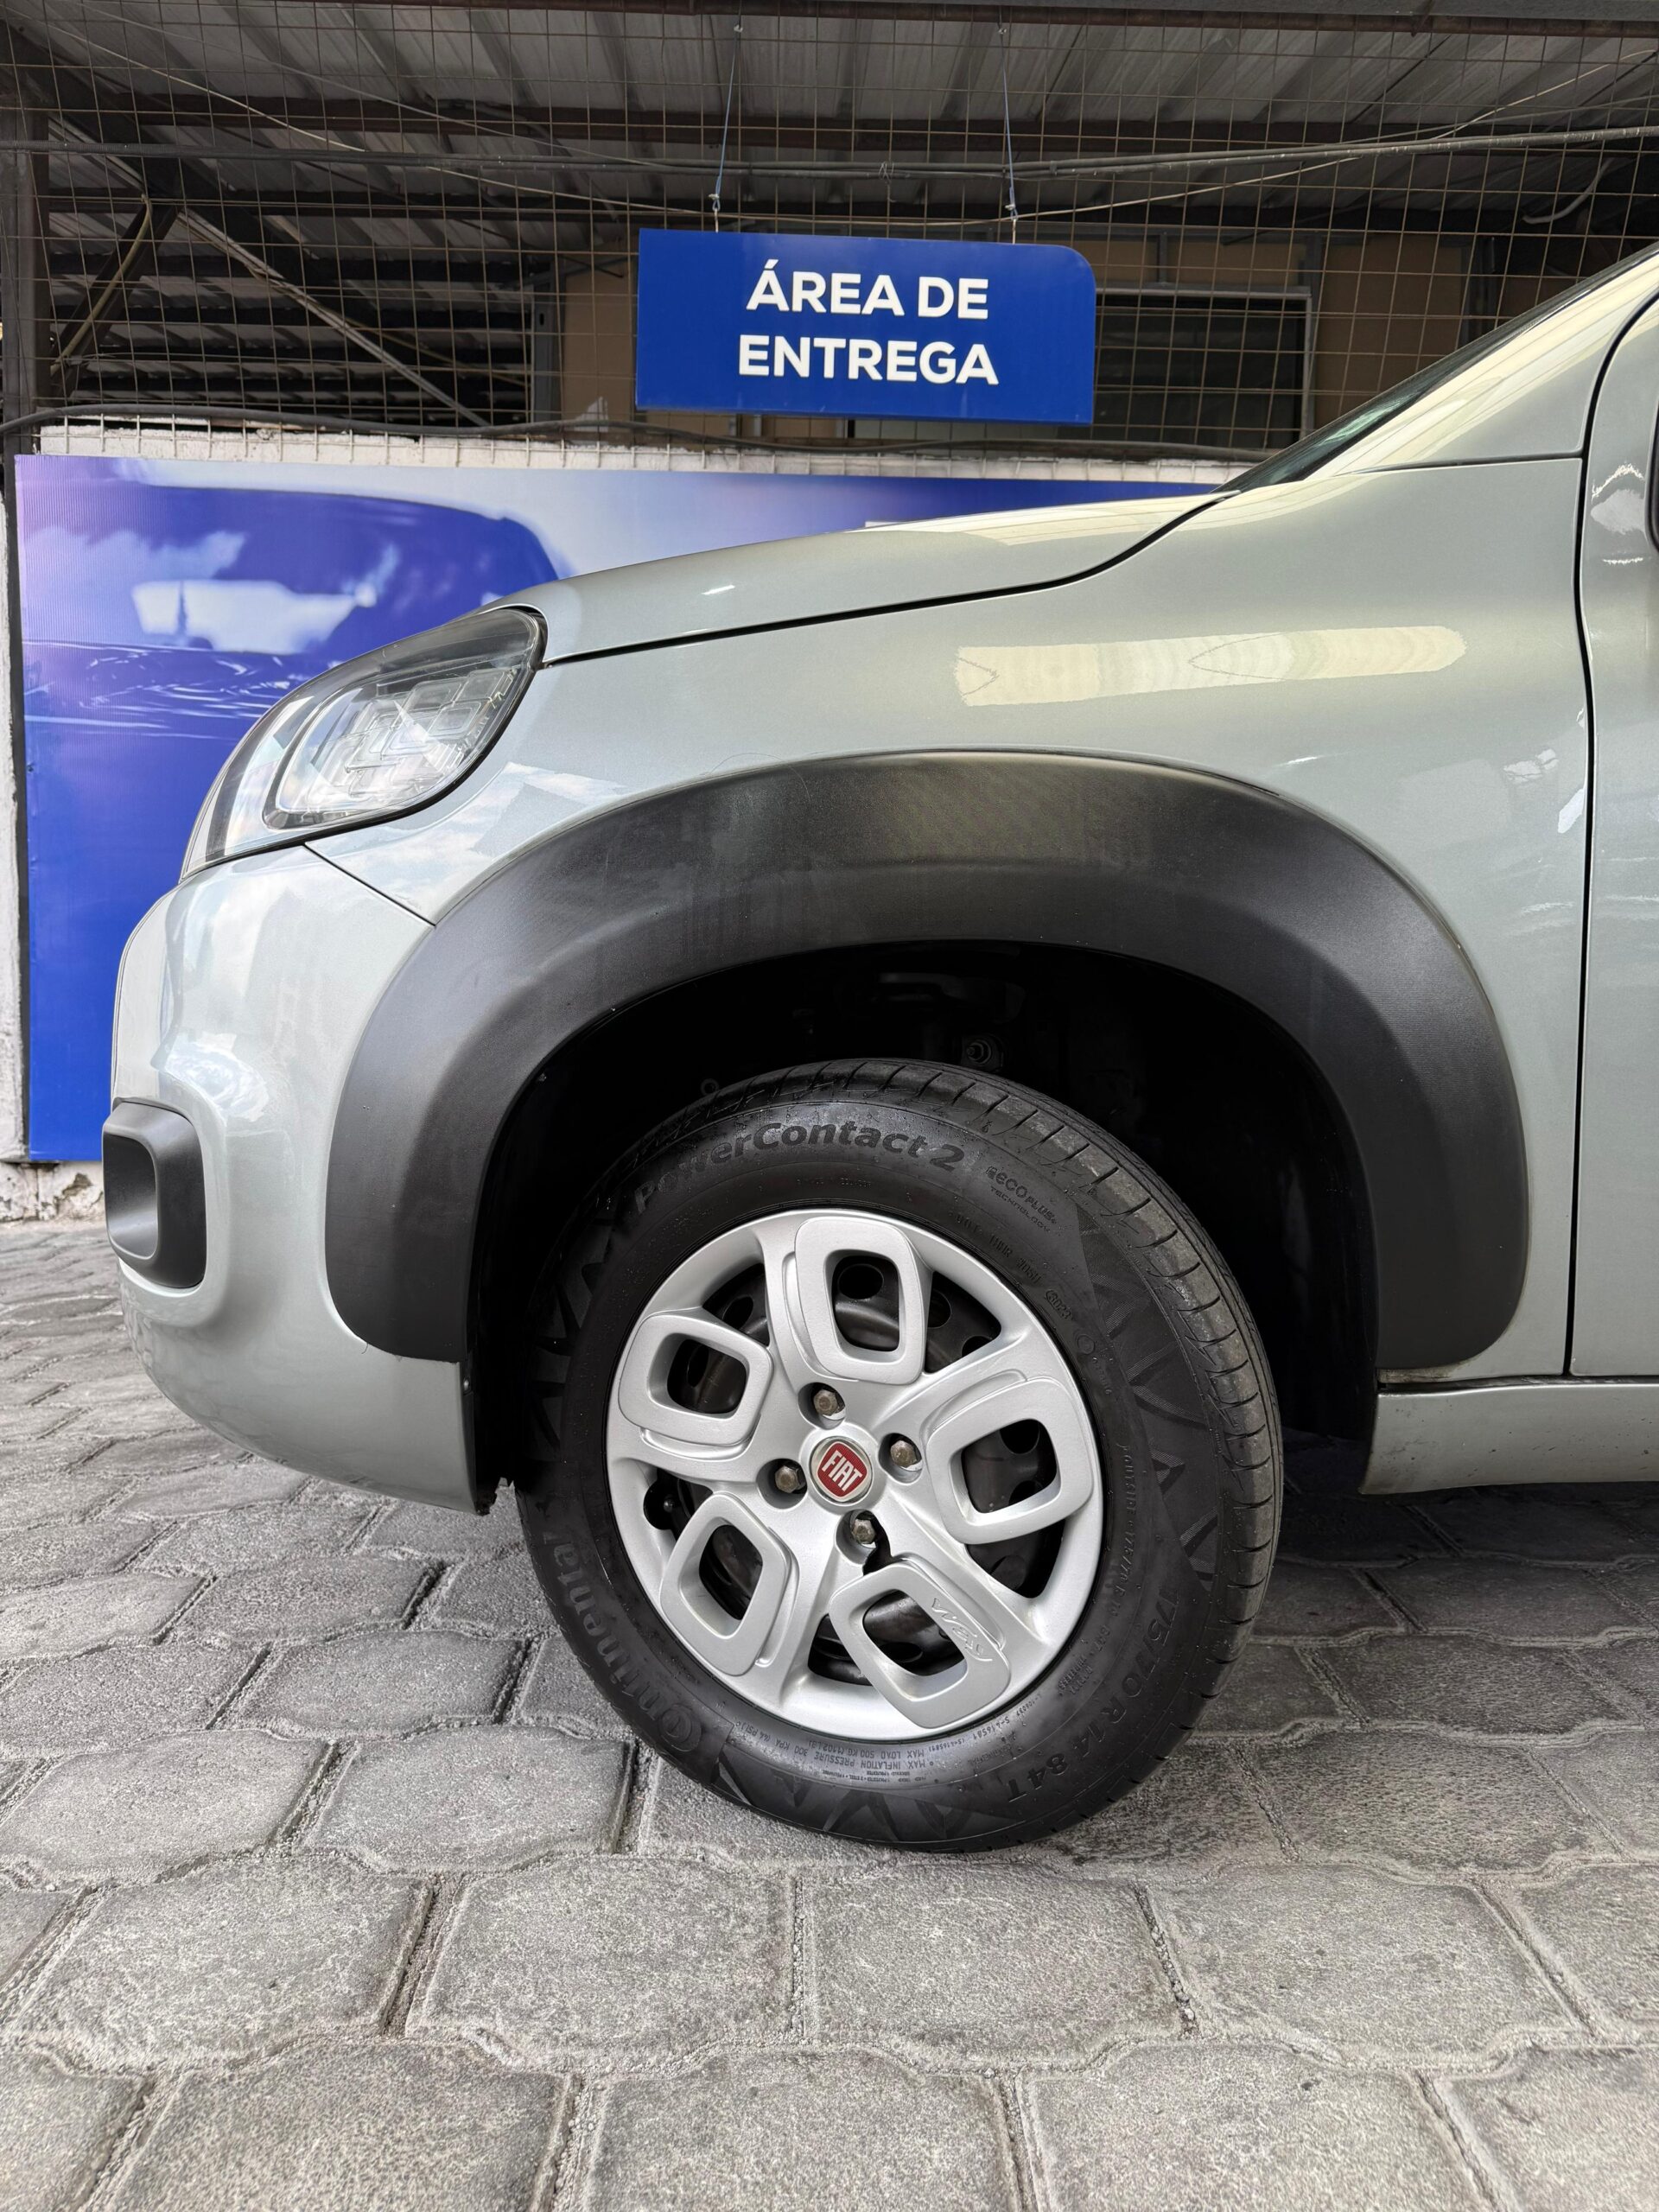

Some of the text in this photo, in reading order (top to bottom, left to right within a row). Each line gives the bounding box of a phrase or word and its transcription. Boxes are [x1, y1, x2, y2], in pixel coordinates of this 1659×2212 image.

[746, 258, 988, 320] ÁREA DE
[739, 334, 999, 386] ENTREGA
[632, 1121, 966, 1215] PowerContact 2
[822, 1450, 863, 1492] FIAT
[1007, 1586, 1181, 1803] 175/70 R 14 84T
[773, 1737, 790, 1751] KPA
[793, 1744, 808, 1757] 300
[813, 1750, 855, 1768] PRESSURE
[860, 1748, 874, 1759] 500
[880, 1750, 901, 1759] LOAD
[860, 1759, 901, 1770] INFLATION
